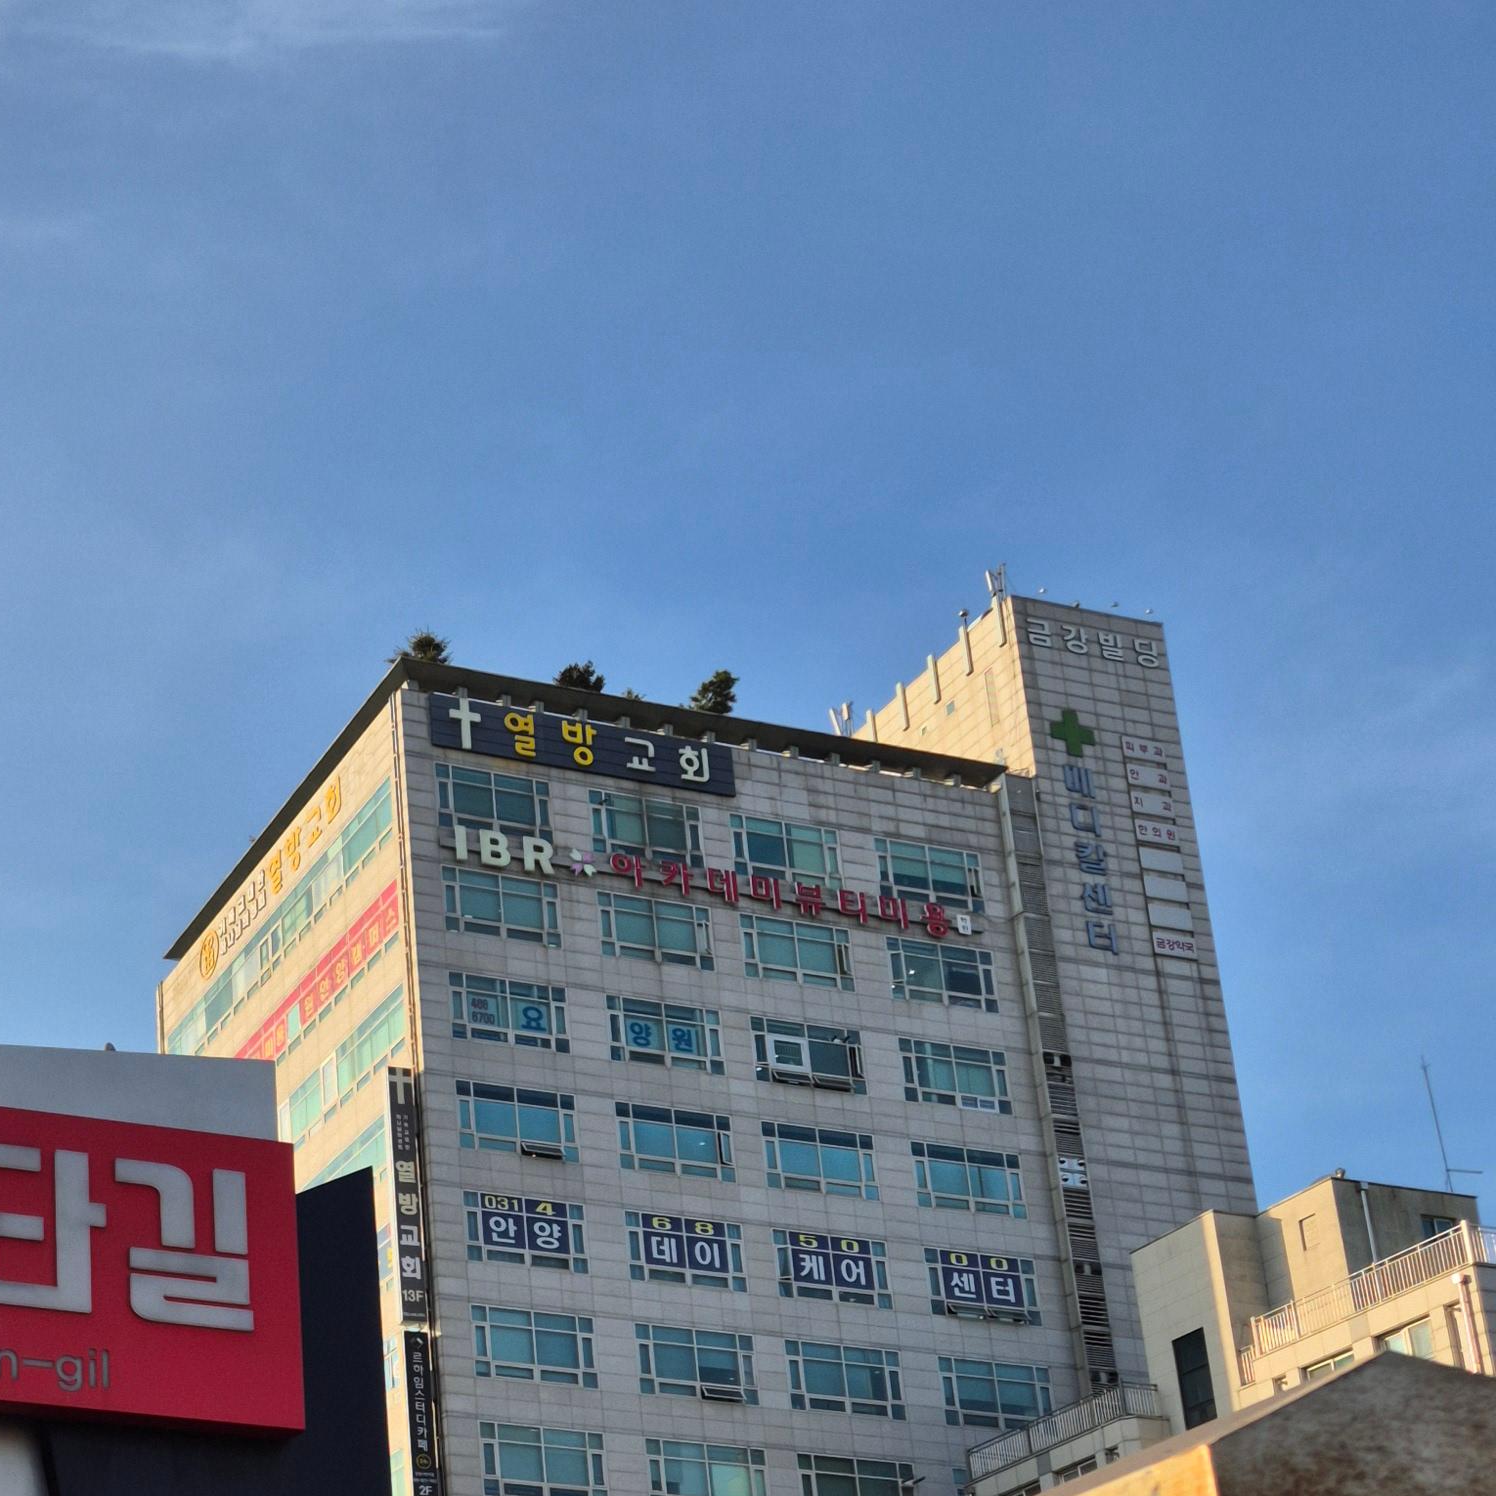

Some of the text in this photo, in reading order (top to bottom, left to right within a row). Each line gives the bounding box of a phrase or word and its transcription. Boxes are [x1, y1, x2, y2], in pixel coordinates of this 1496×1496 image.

[1027, 617, 1160, 669] 금강빌딩
[504, 711, 711, 783] 열방교회
[1125, 741, 1163, 757] 피부과
[267, 774, 343, 895] 열방교회
[454, 825, 555, 875] IBR
[1138, 824, 1176, 841] 한의원
[1062, 763, 1120, 956] 메디칼센터
[609, 852, 954, 938] 아카데미뷰티미용
[521, 1005, 547, 1033] 요
[483, 1194, 520, 1213] 031
[535, 1202, 555, 1216] 4
[489, 1215, 562, 1250] 안양
[401, 1289, 425, 1302] 13F
[418, 1485, 434, 1496] 2F
